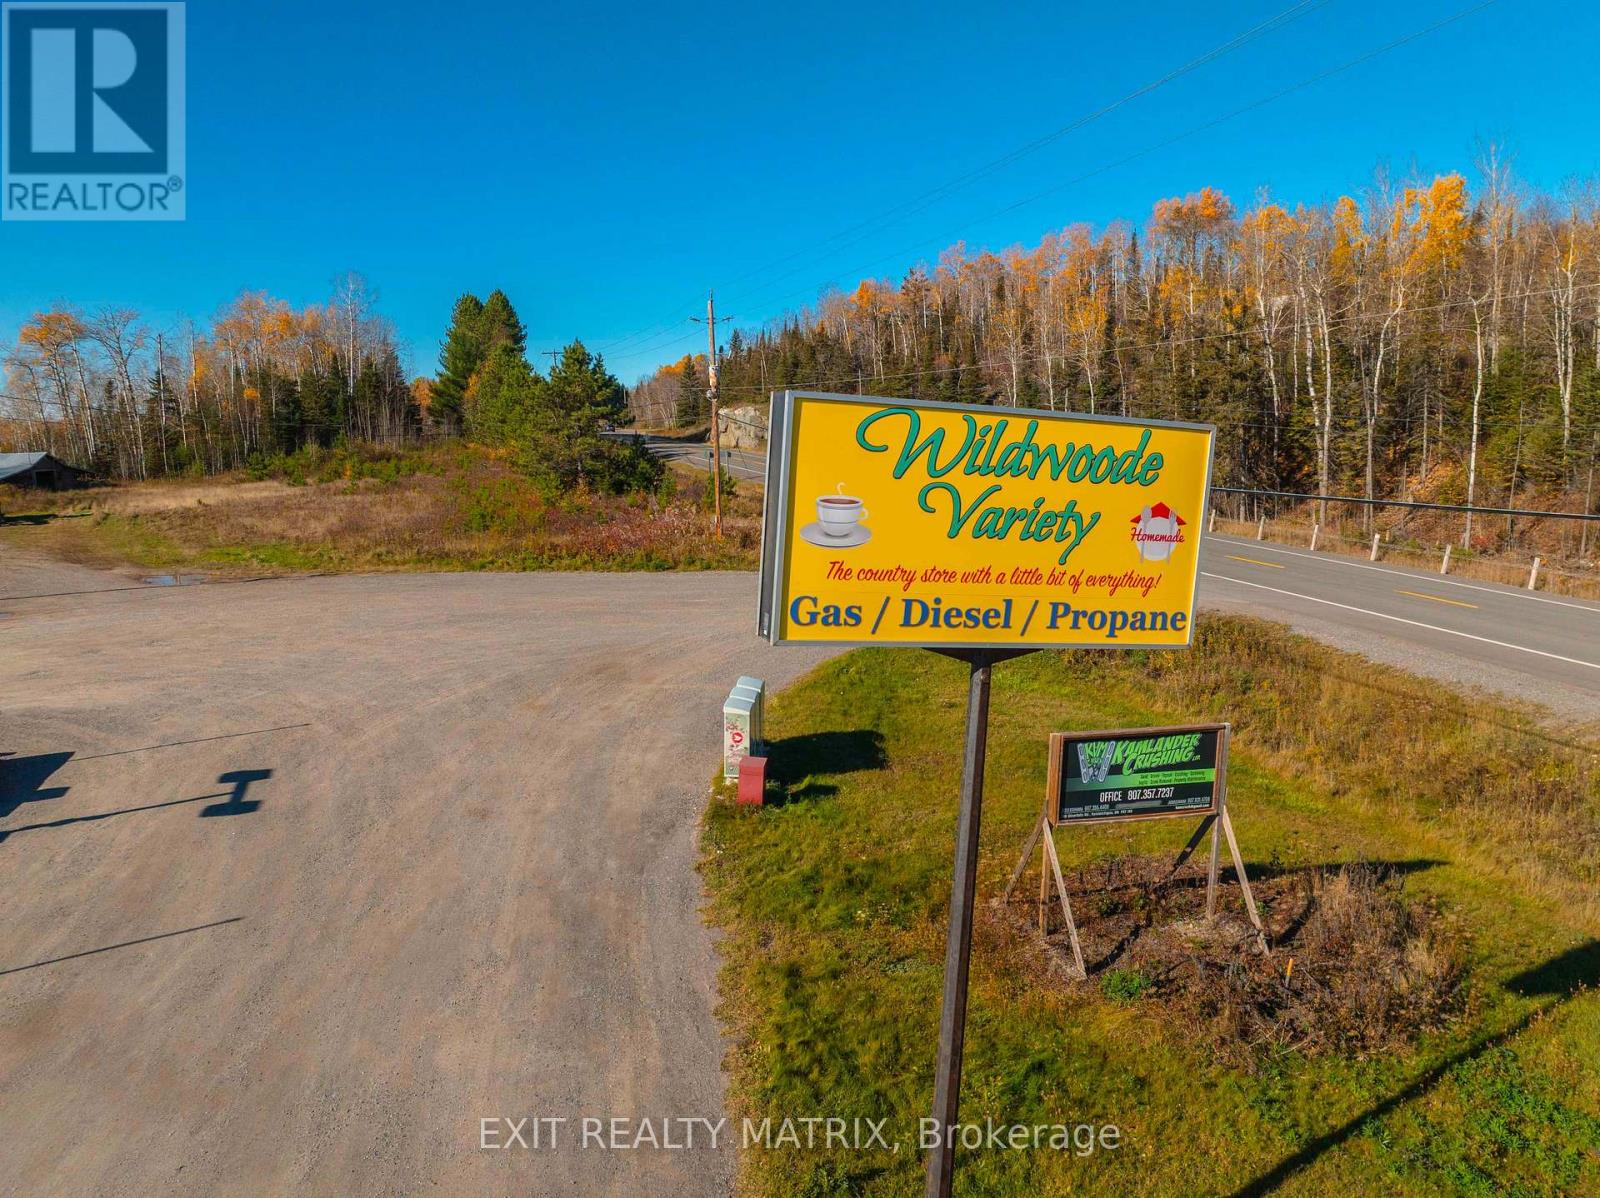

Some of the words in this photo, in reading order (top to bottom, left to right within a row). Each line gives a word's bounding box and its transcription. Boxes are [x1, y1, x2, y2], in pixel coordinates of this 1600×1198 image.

[856, 407, 1163, 486] Wildwoode
[918, 482, 1101, 565] Variety
[1130, 527, 1185, 543] Homemade
[827, 560, 852, 580] The
[857, 564, 917, 592] country
[921, 565, 957, 583] store
[960, 564, 992, 584] with
[996, 572, 1006, 584] a
[1010, 566, 1043, 585] little
[1046, 569, 1066, 587] bit
[1068, 569, 1085, 593] of
[1085, 569, 1162, 597] everything!
[789, 595, 862, 627] Gas
[870, 596, 890, 635] /
[899, 597, 1013, 629] Diesel
[1020, 599, 1039, 637] /
[1046, 601, 1187, 638] Propane
[1122, 746, 1195, 776] CRUSHING
[1100, 791, 1122, 803] OFFICE
[1127, 786, 1175, 801] 807.357.7237
